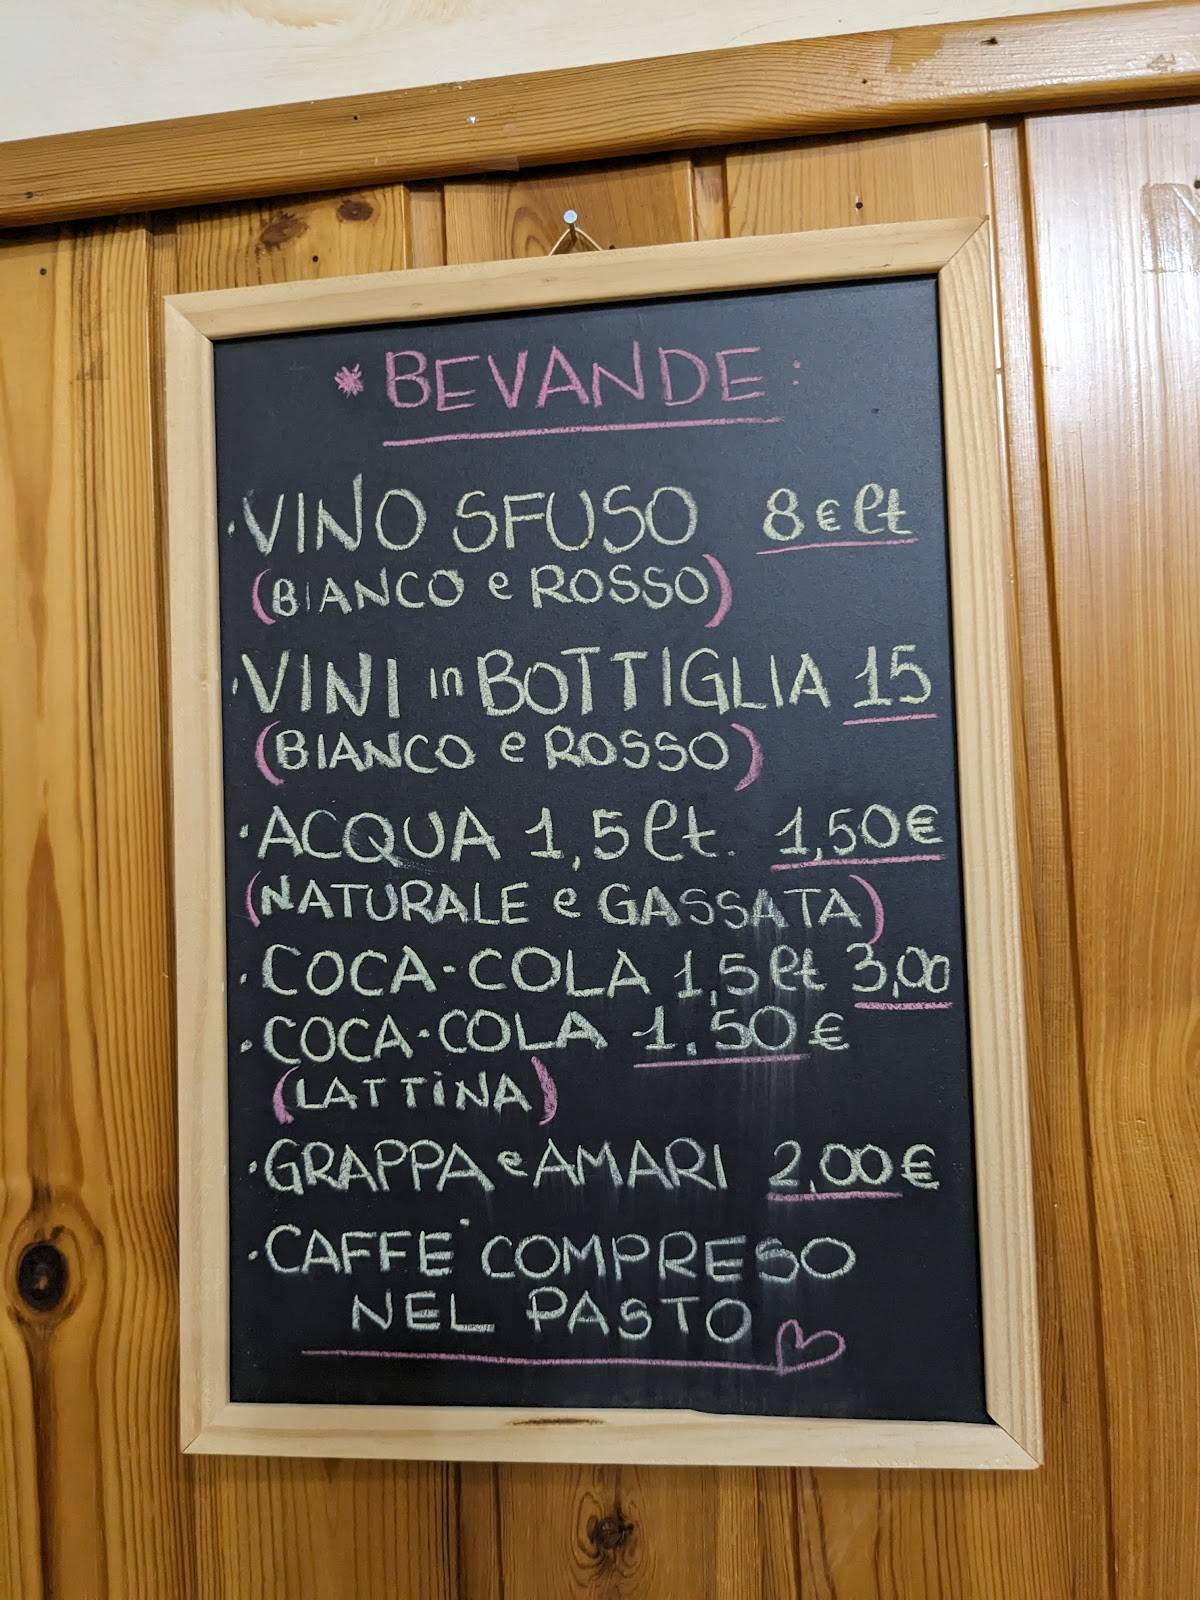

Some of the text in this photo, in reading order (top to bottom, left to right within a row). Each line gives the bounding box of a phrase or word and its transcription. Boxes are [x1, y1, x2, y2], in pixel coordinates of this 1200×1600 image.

[242, 474, 427, 556] VINO
[452, 484, 698, 557] SFUSO
[491, 574, 513, 601] e
[242, 644, 933, 720] VINI in BOTTIGLIA 15
[500, 731, 526, 764] e
[256, 804, 503, 869] ACQUA
[522, 804, 630, 873] 1,5
[776, 803, 946, 864] 1,50€
[553, 893, 581, 918] e
[261, 943, 652, 1000] COCA-COLA
[850, 942, 952, 998] 3,00
[263, 1006, 609, 1067] COCA-COLA
[263, 1138, 496, 1197] GRAPPA
[498, 1150, 530, 1178] e
[532, 1136, 728, 1191] AMARI
[480, 1230, 858, 1283] COMPRESO
[350, 1285, 754, 1345] NEL PASTO
